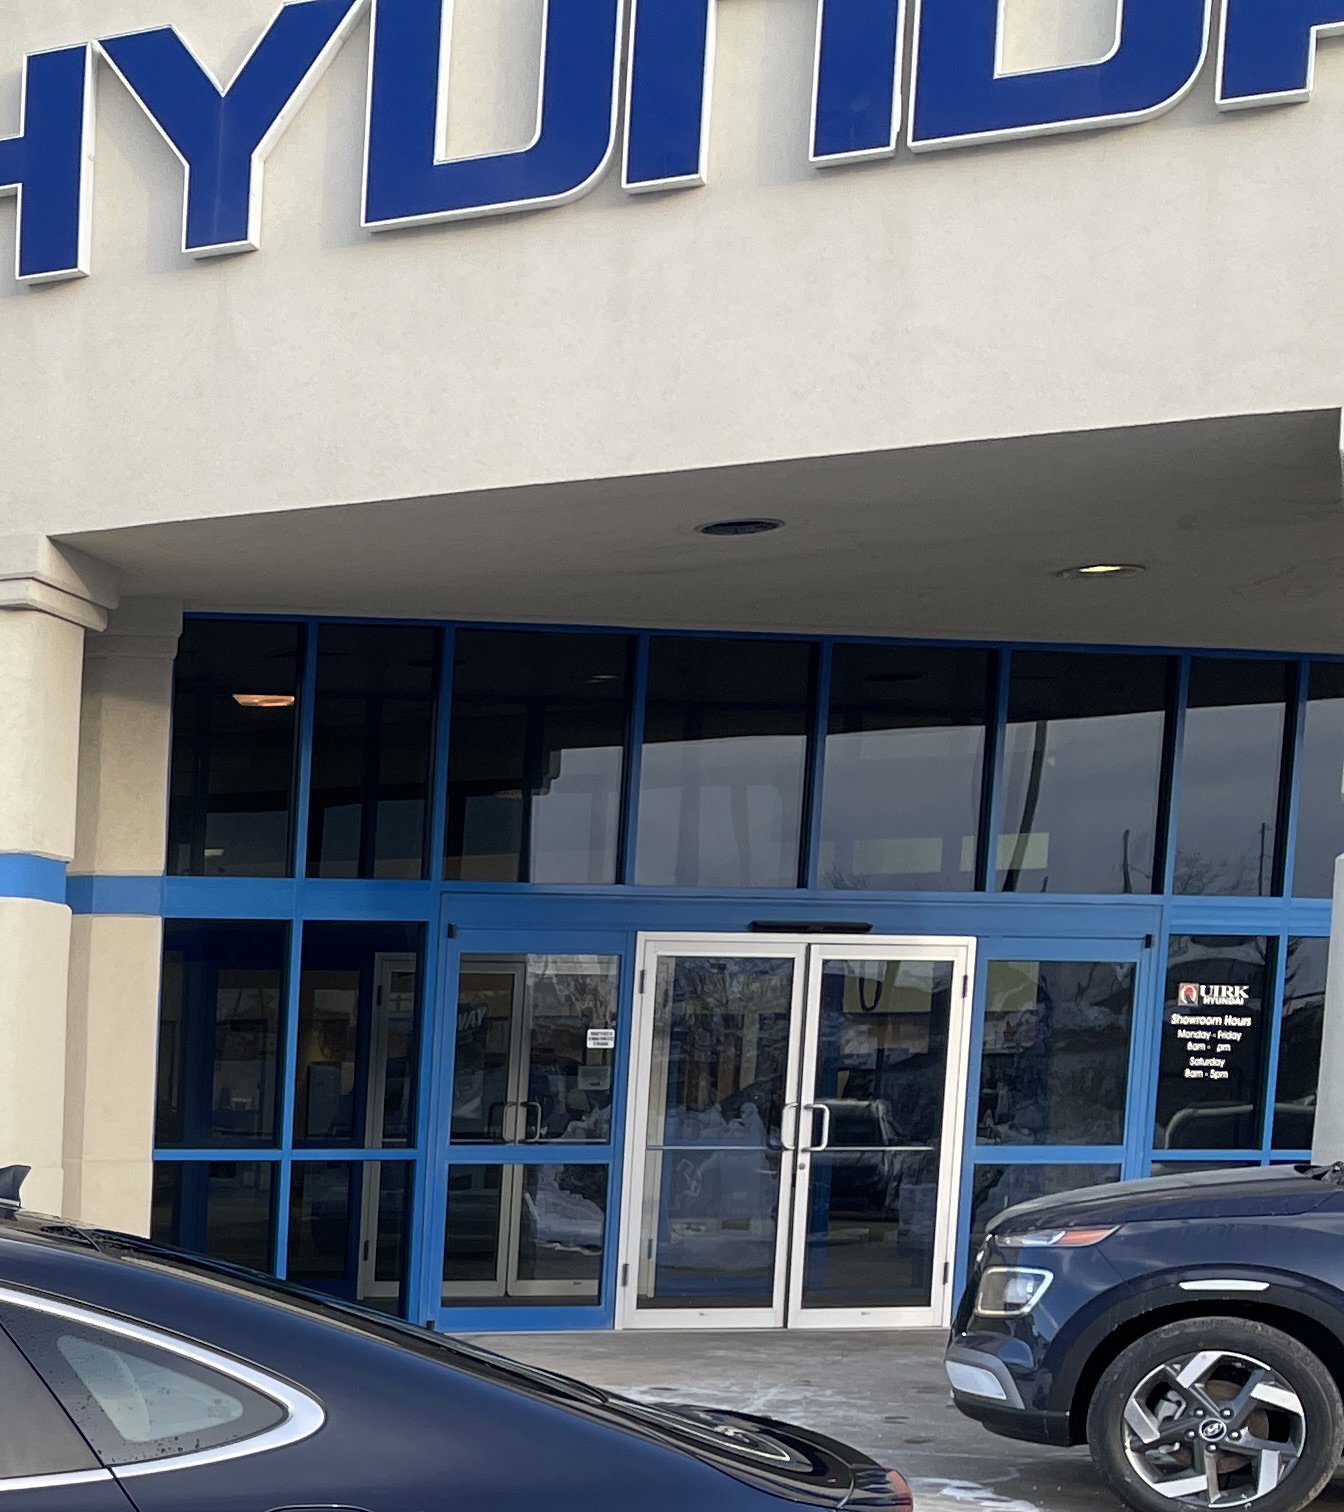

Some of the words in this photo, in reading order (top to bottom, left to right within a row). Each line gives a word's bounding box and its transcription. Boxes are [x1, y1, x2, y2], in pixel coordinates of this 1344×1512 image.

[1170, 1013, 1222, 1025] Showroom
[1223, 1015, 1252, 1026] Hours
[1177, 1029, 1212, 1040] Monday
[1217, 1030, 1243, 1041] Friday
[1189, 1056, 1226, 1068] Saturday
